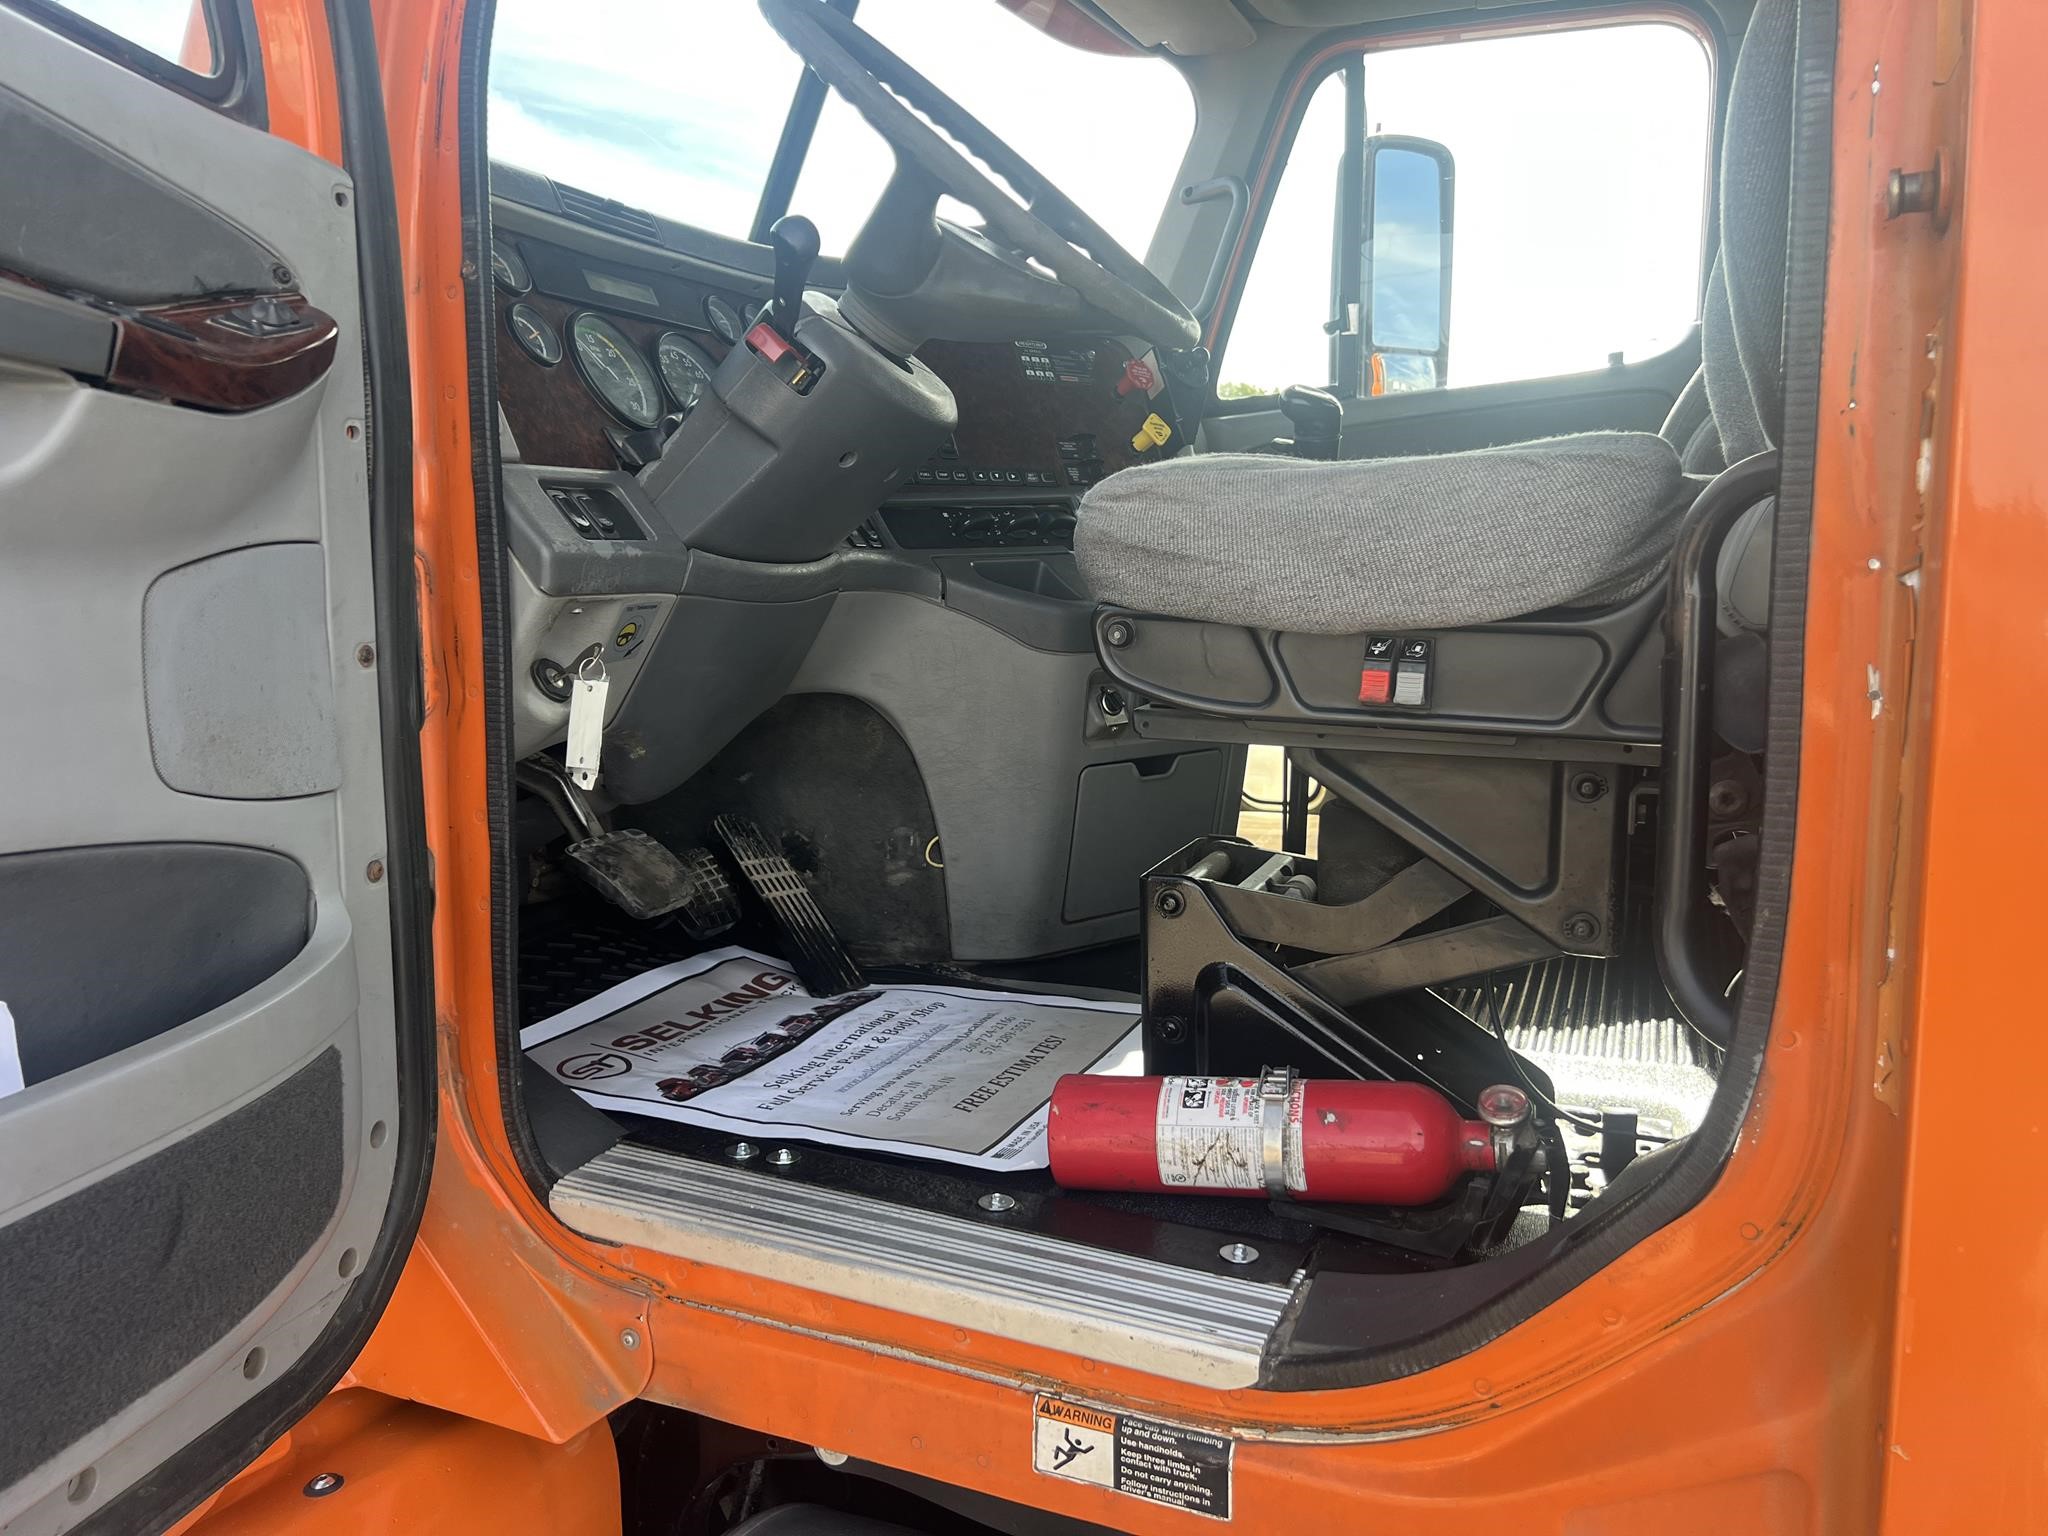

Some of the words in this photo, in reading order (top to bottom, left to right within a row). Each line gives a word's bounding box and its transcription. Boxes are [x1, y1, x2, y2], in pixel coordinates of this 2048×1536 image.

[612, 972, 792, 1051] SELKING
[757, 1093, 794, 1111] Full
[787, 1063, 845, 1095] Service
[839, 1043, 879, 1064] Paint
[872, 1034, 890, 1044] &
[884, 1017, 920, 1036] Body
[911, 1001, 947, 1019] Shop
[763, 1060, 824, 1090] Selking
[815, 1010, 899, 1062] International
[953, 1085, 999, 1113] FREE
[988, 1035, 1067, 1088] ESTIMATES!
[840, 1091, 883, 1116] Serving
[879, 1080, 896, 1092] you
[886, 1100, 921, 1121] South
[1053, 1404, 1112, 1429] WARNING
[1120, 1436, 1137, 1447] Use
[1139, 1441, 1185, 1459] handholds.
[1121, 1426, 1132, 1435] up
[1134, 1428, 1150, 1438] and
[1152, 1432, 1177, 1444] down.
[1122, 1418, 1142, 1428] Face
[1145, 1424, 1159, 1433] cab
[1162, 1428, 1184, 1438] when
[1187, 1433, 1223, 1448] climbing
[1120, 1448, 1142, 1460] Keep
[1144, 1454, 1165, 1466] three
[1167, 1460, 1190, 1471] limbs
[1193, 1464, 1200, 1474] in
[1120, 1457, 1151, 1468] contact
[1153, 1463, 1171, 1474] with
[1173, 1468, 1197, 1480] truck.
[1120, 1466, 1132, 1475] Do
[1134, 1470, 1148, 1479] not
[1150, 1475, 1171, 1486] carry
[1174, 1480, 1213, 1496] anything.
[1120, 1477, 1148, 1489] Follow
[1150, 1484, 1200, 1504] instructions
[1202, 1498, 1211, 1507] in
[1121, 1484, 1151, 1497] driver's
[1153, 1492, 1187, 1507] manual.
